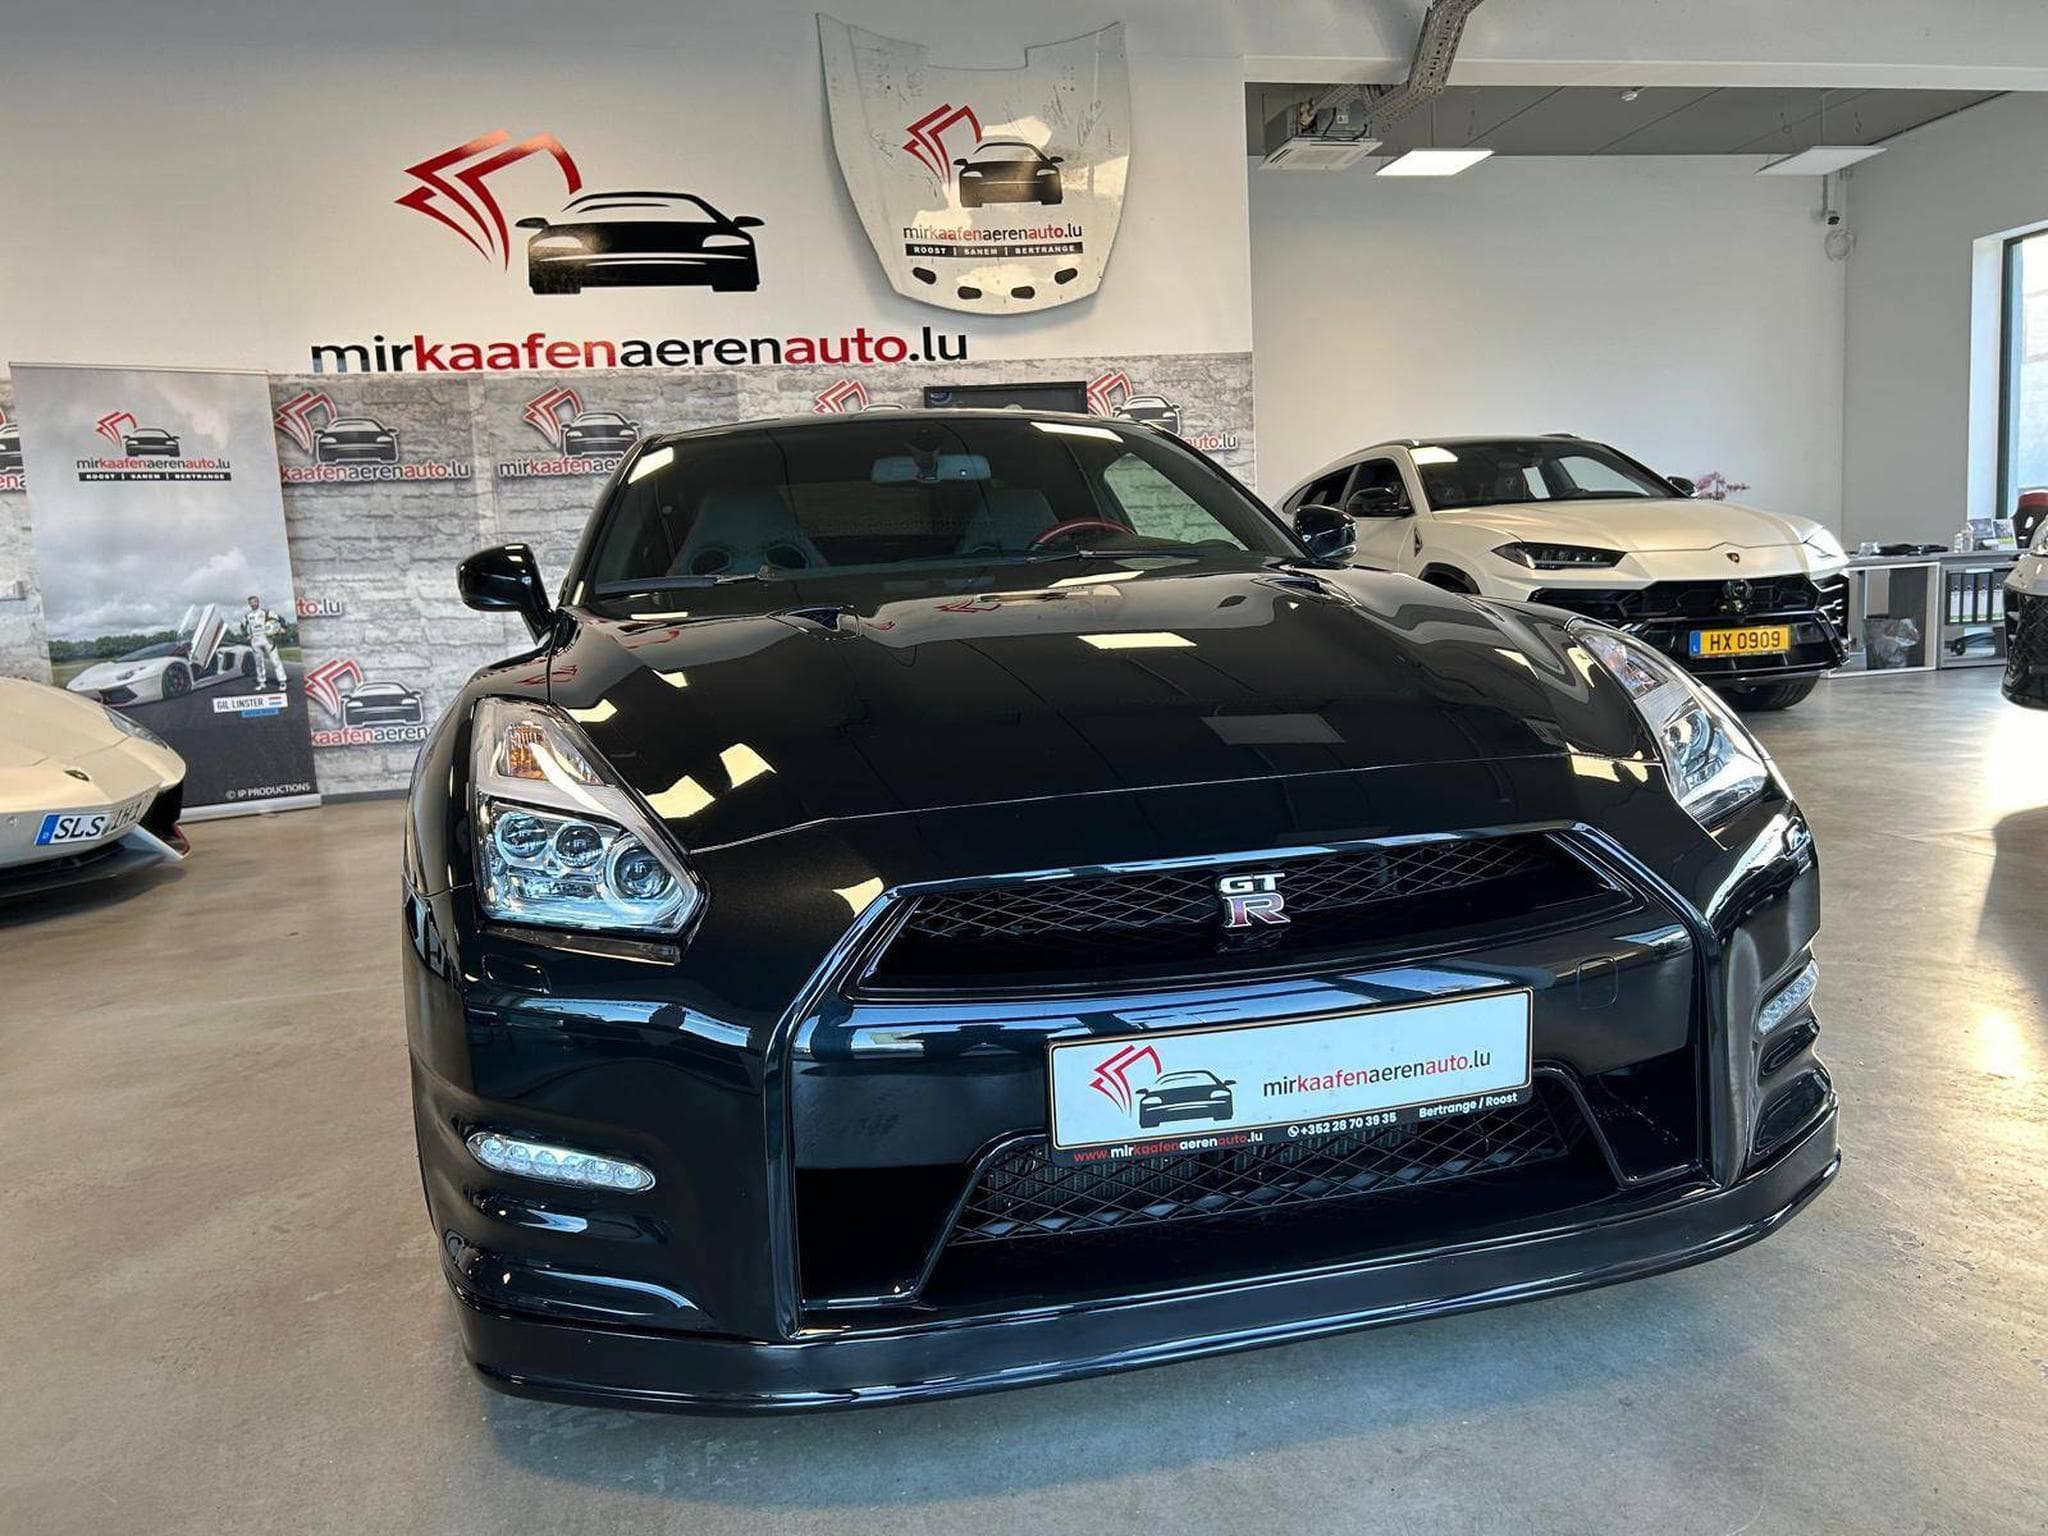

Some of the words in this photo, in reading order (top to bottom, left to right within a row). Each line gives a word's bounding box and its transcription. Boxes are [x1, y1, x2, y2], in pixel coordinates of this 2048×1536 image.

[903, 223, 1082, 241] mirkaafenaerenauto.lu
[914, 246, 947, 255] ROOST
[964, 247, 998, 256] SANEM
[310, 326, 968, 373] mirkaafenaerenauto.lu
[76, 457, 231, 470] mirkaafenaerenauto.lu
[1710, 633, 1732, 651] HX
[1737, 631, 1781, 650] 0909
[248, 782, 311, 797] PRODUCTIONS
[54, 816, 105, 840] SLS
[1263, 1050, 1491, 1097] mirkaafenaerenauto.lu
[1073, 1131, 1263, 1162] www.mirkaafenaerenauto.lu
[1300, 1121, 1330, 1136] +352
[1332, 1119, 1347, 1132] 28
[1349, 1117, 1363, 1130] 70
[1365, 1115, 1380, 1128] 39
[1381, 1112, 1397, 1124] 35
[1419, 1100, 1477, 1118] Bertrange
[1486, 1092, 1518, 1106] Roost
